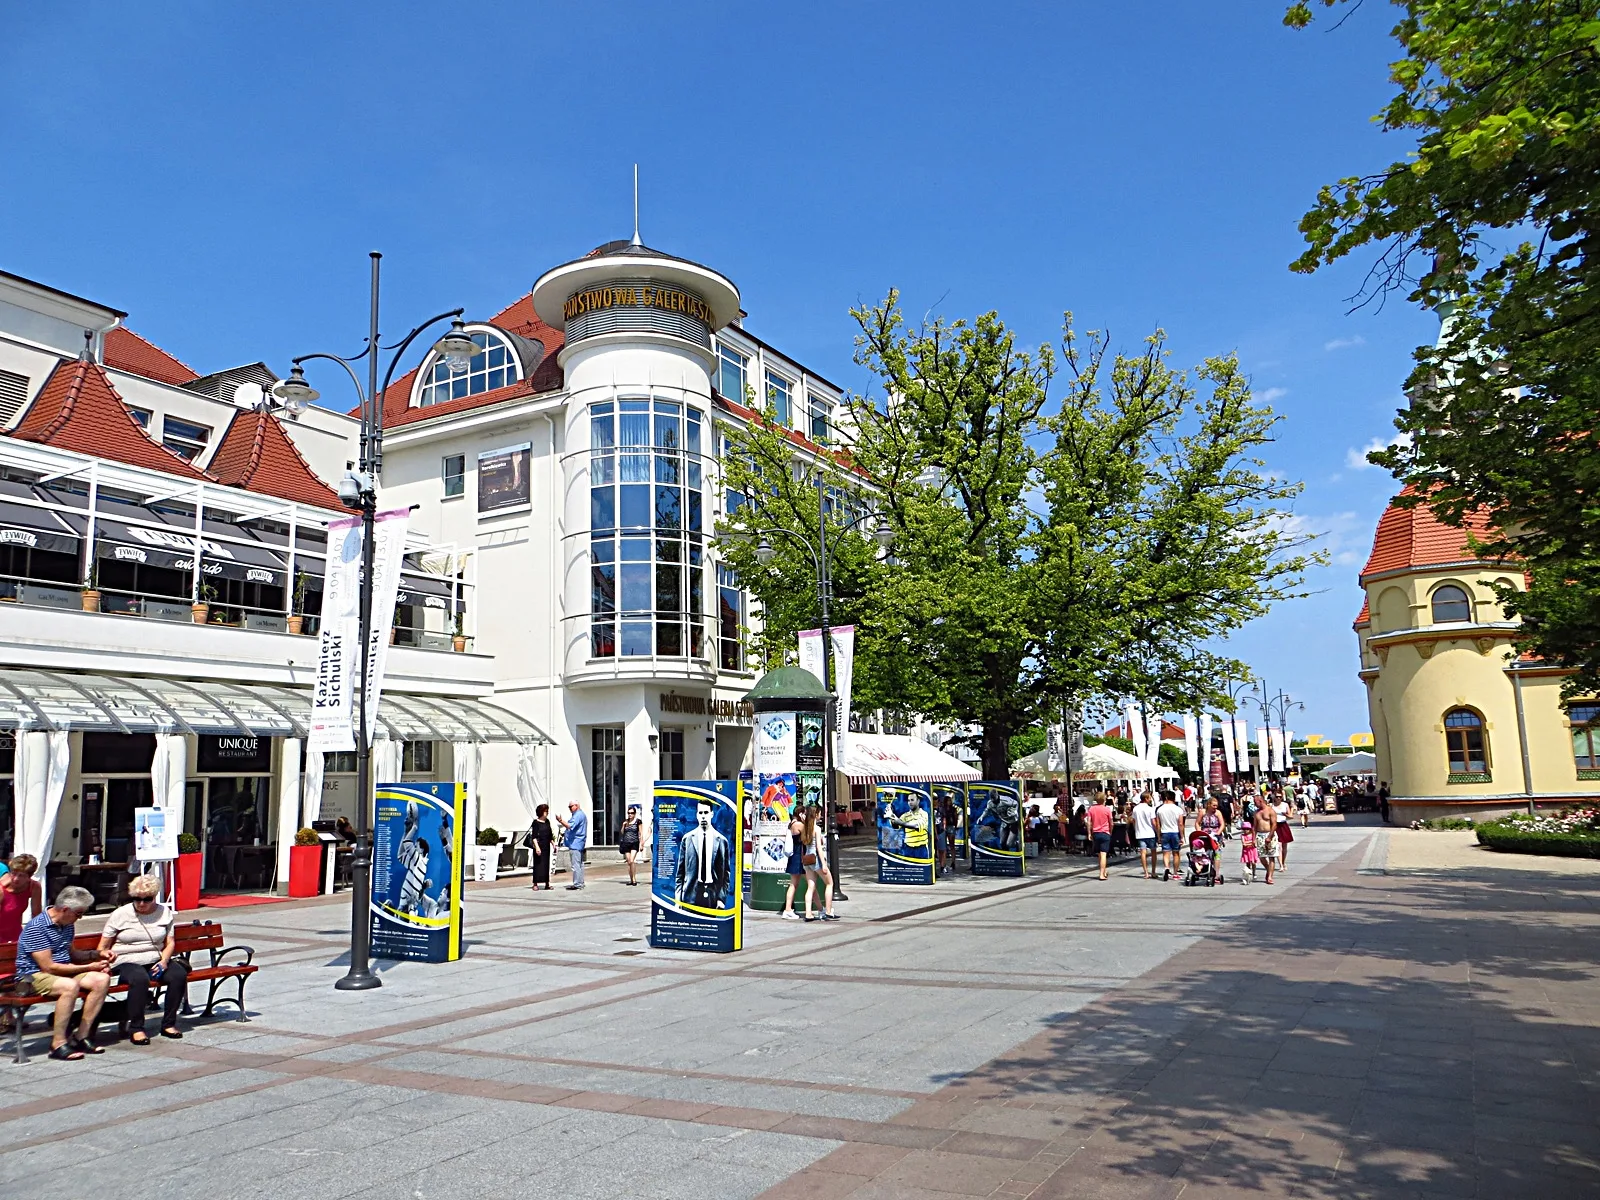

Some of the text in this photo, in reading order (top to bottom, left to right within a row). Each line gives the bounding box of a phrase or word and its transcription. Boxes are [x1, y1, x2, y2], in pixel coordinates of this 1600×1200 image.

[641, 286, 697, 318] GALERIA
[174, 559, 223, 575] avoado
[315, 629, 331, 708] Kazimierz
[328, 635, 342, 707] Sichulski
[218, 737, 259, 752] UNIQUE
